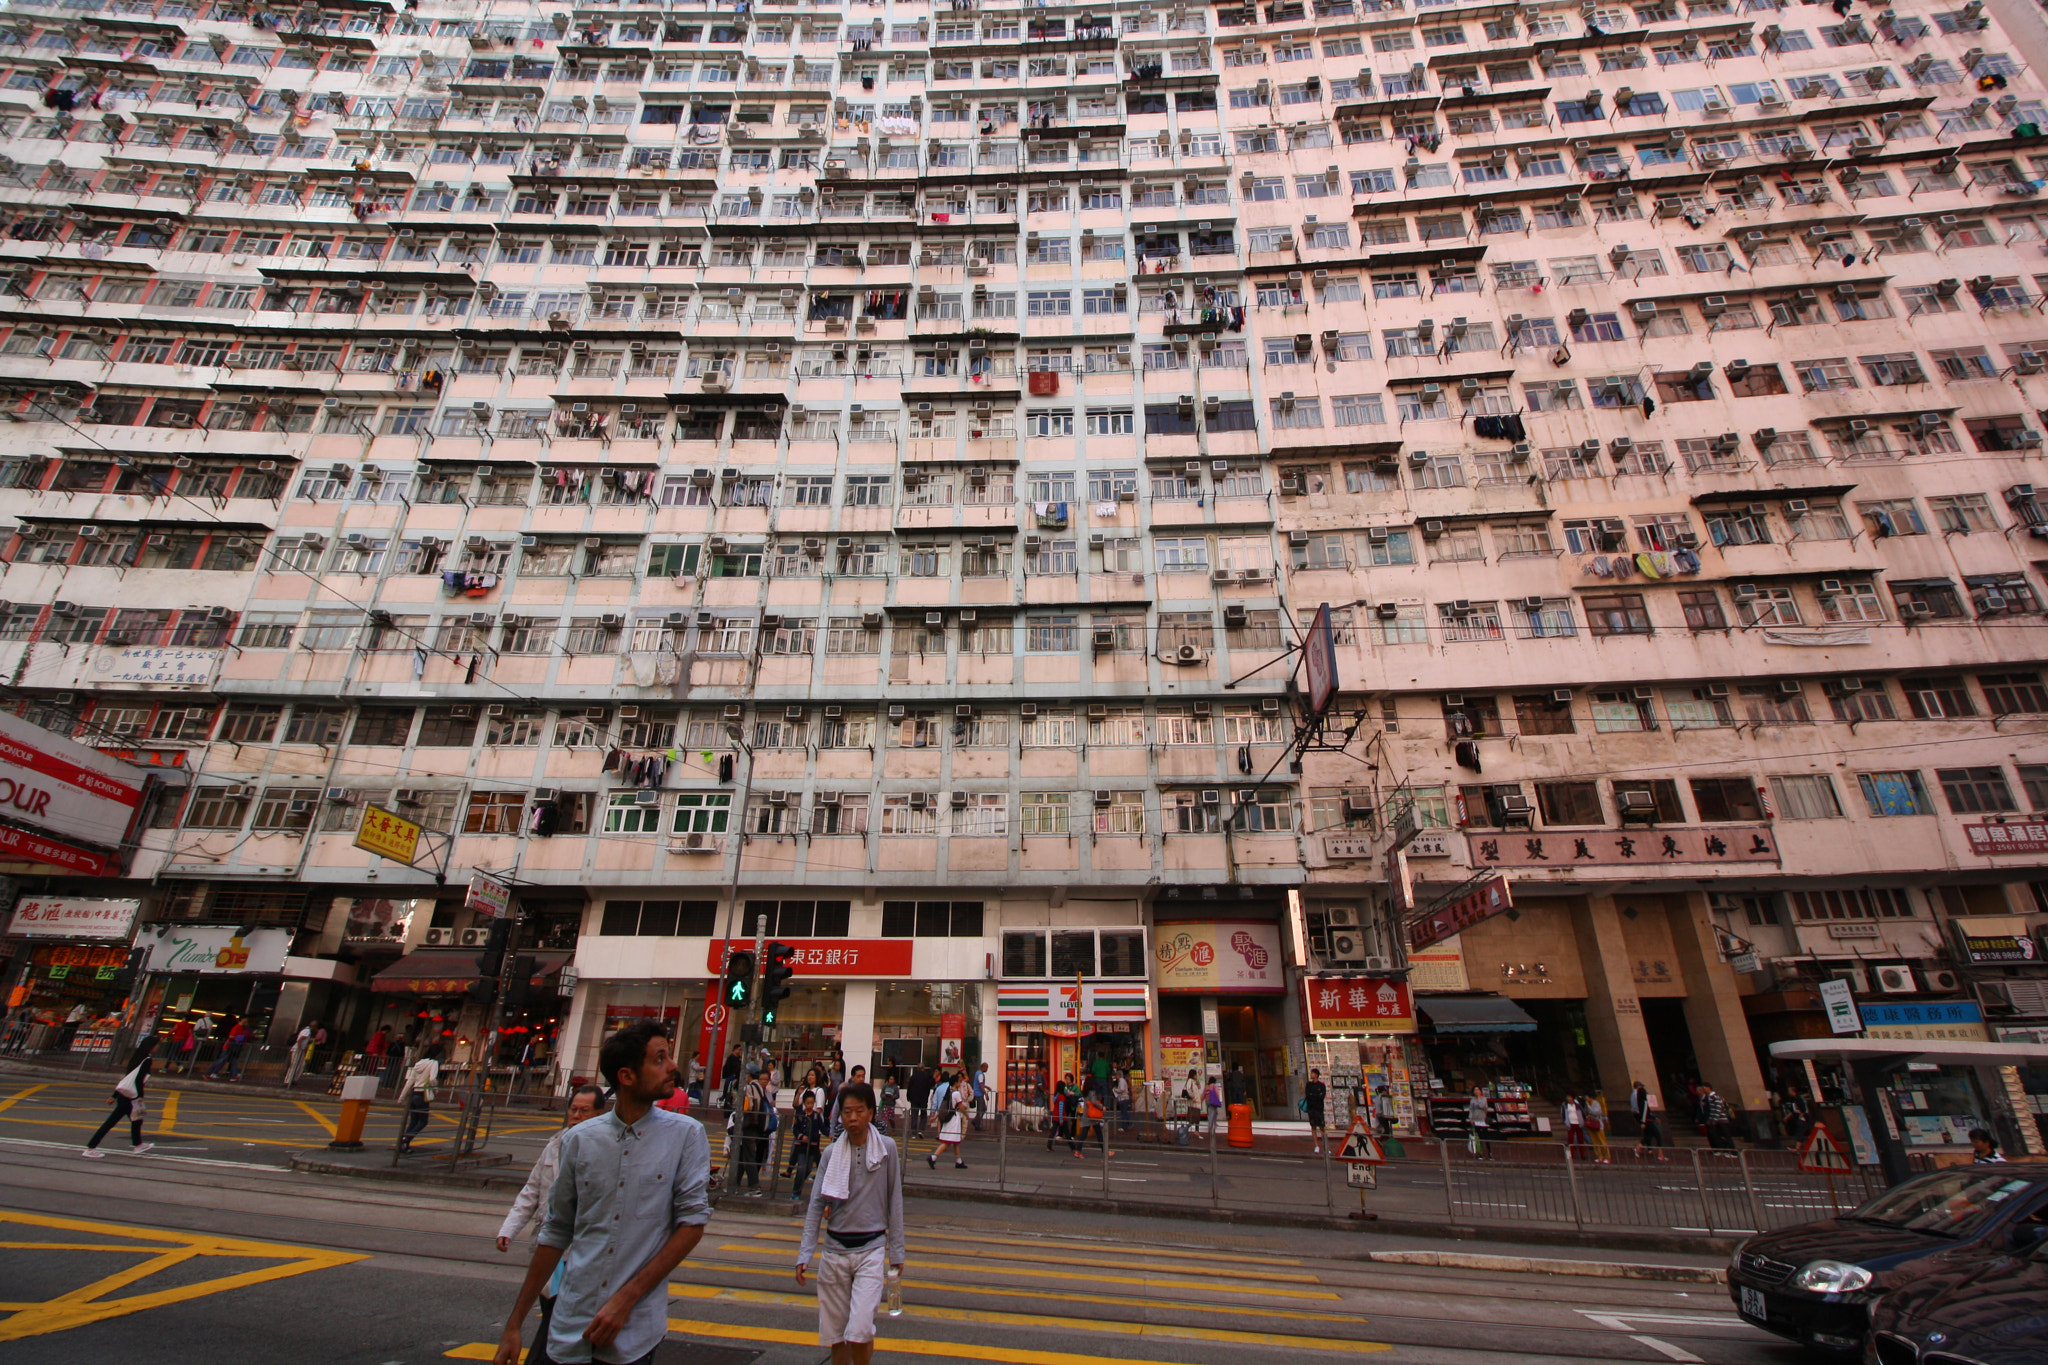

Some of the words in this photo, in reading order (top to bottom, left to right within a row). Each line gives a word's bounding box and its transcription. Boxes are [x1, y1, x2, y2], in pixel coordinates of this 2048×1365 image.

[366, 810, 415, 844] 大發文具
[1968, 824, 2048, 843] 鰂魚涌居
[216, 949, 249, 967] One
[789, 949, 859, 965] 東亞銀行
[1318, 986, 1369, 1013] 新華
[1379, 993, 1395, 1001] SW
[1376, 1003, 1403, 1016] 地產
[1862, 1006, 1963, 1021] 德康醫務所
[1352, 1163, 1371, 1171] End
[1352, 1173, 1372, 1184] 終止
